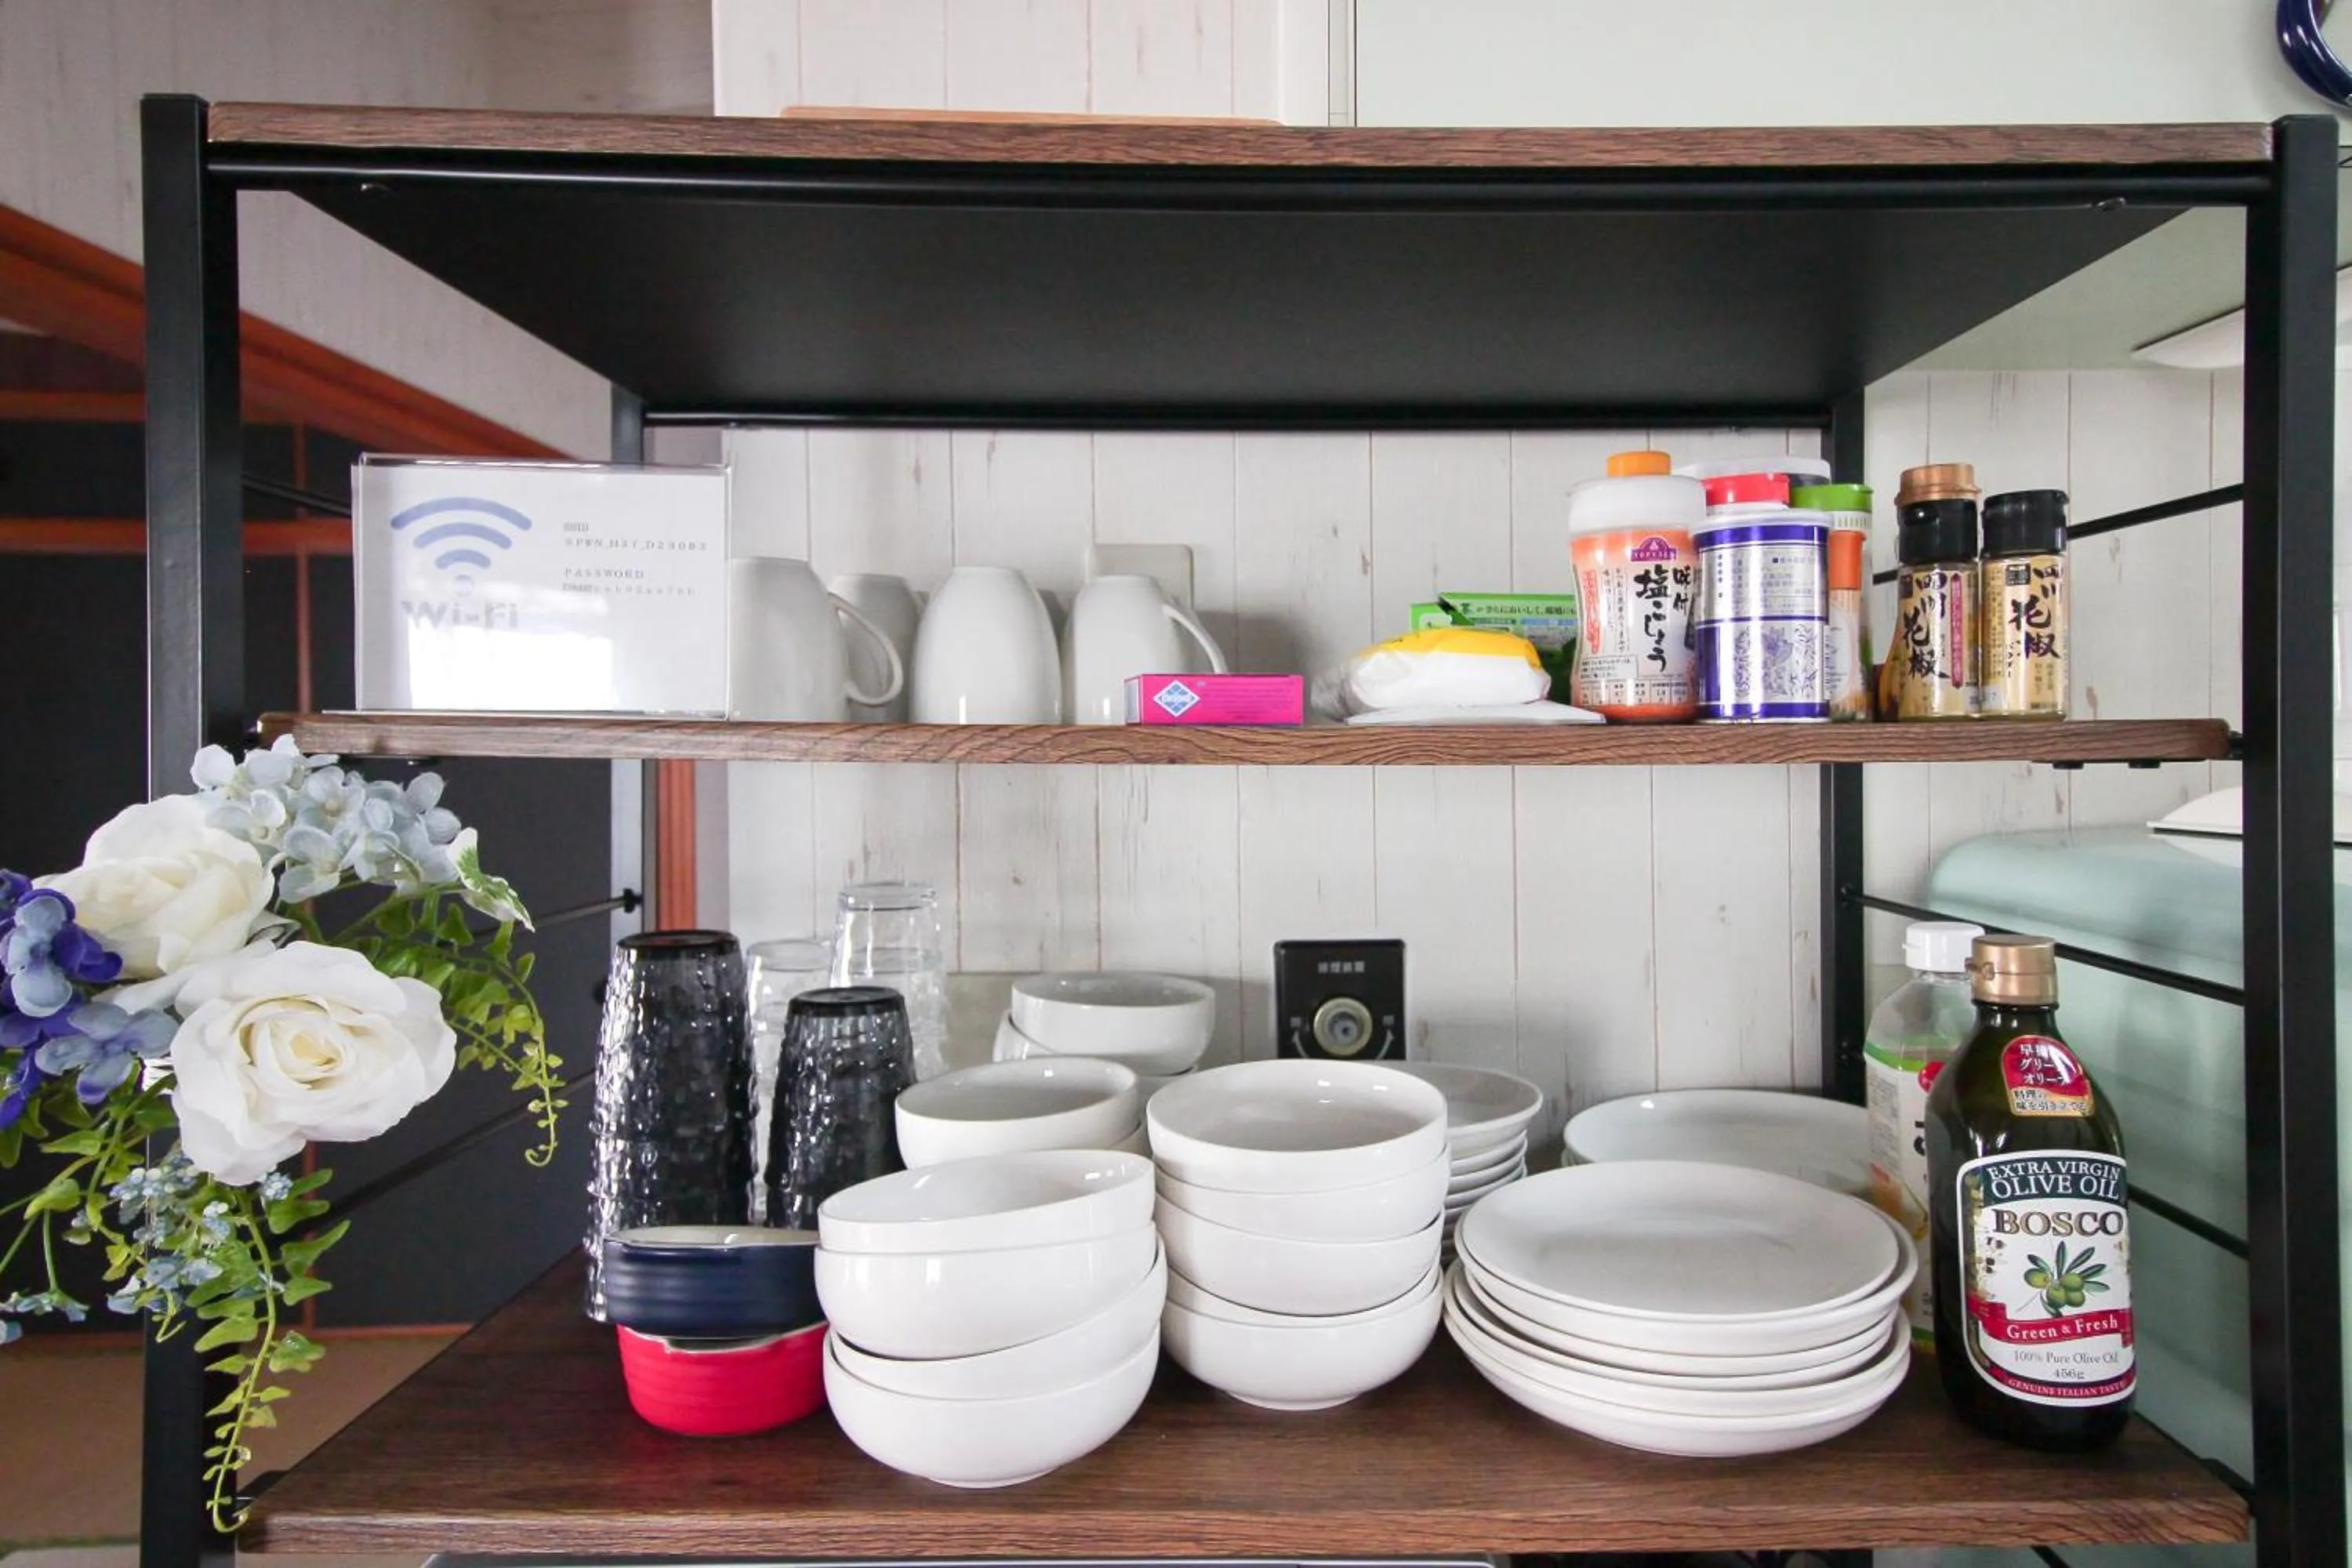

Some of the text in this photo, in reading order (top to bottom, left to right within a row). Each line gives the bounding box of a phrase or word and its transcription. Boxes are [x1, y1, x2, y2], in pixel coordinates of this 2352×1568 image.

[1633, 564, 1671, 673] 塩こしょう
[1987, 1161, 2121, 1180] EXTRA VIRGIN
[1991, 1174, 2119, 1200] OLIVE OIL
[1991, 1208, 2124, 1237] BOSCO
[2006, 1323, 2057, 1339] Green
[2074, 1313, 2118, 1333] Fresh
[2045, 1351, 2071, 1363] Pure
[2072, 1352, 2100, 1363] Olive
[2008, 1379, 2054, 1395] GENUINE
[2056, 1386, 2097, 1396] ITALIAN
